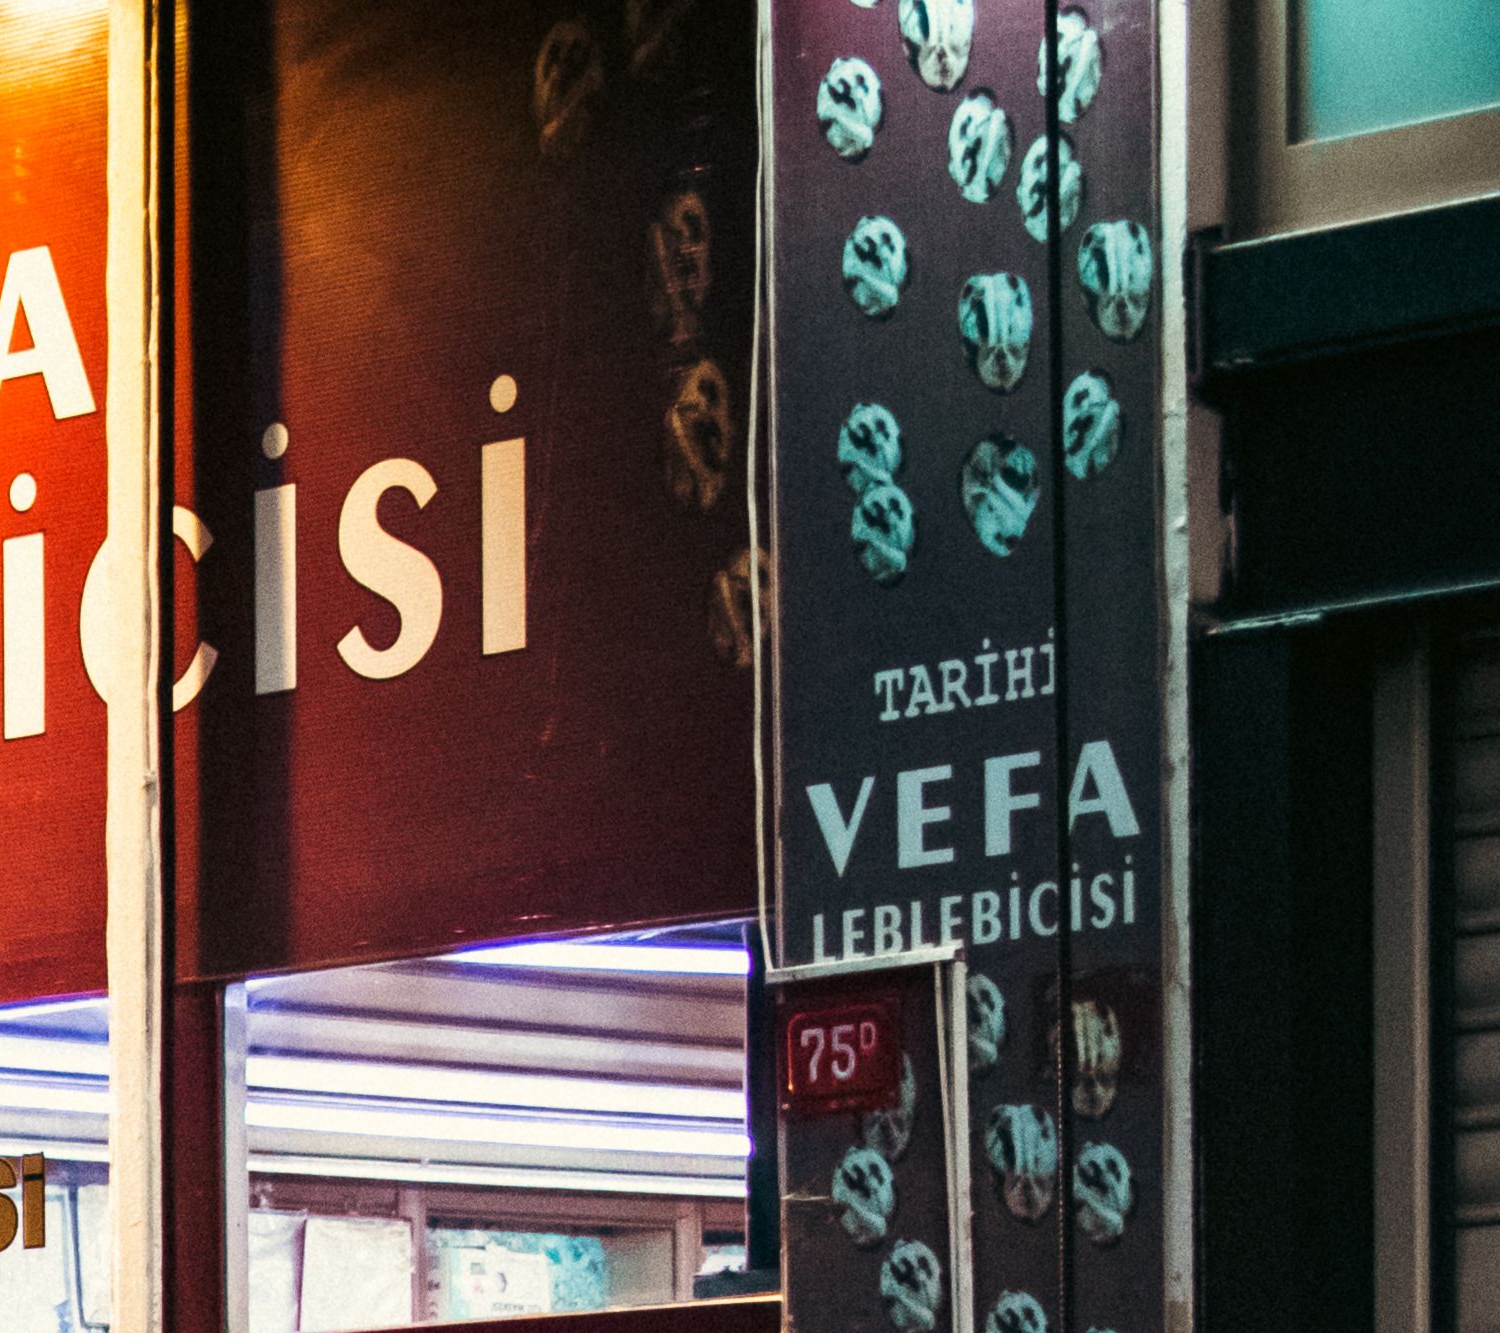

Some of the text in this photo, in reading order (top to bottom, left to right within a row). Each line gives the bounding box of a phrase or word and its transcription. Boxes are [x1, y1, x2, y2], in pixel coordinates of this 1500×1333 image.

[874, 627, 1057, 721] TARİHİ
[806, 740, 1141, 878] VEFA
[812, 855, 1136, 964] LEBLEBİCİSİ
